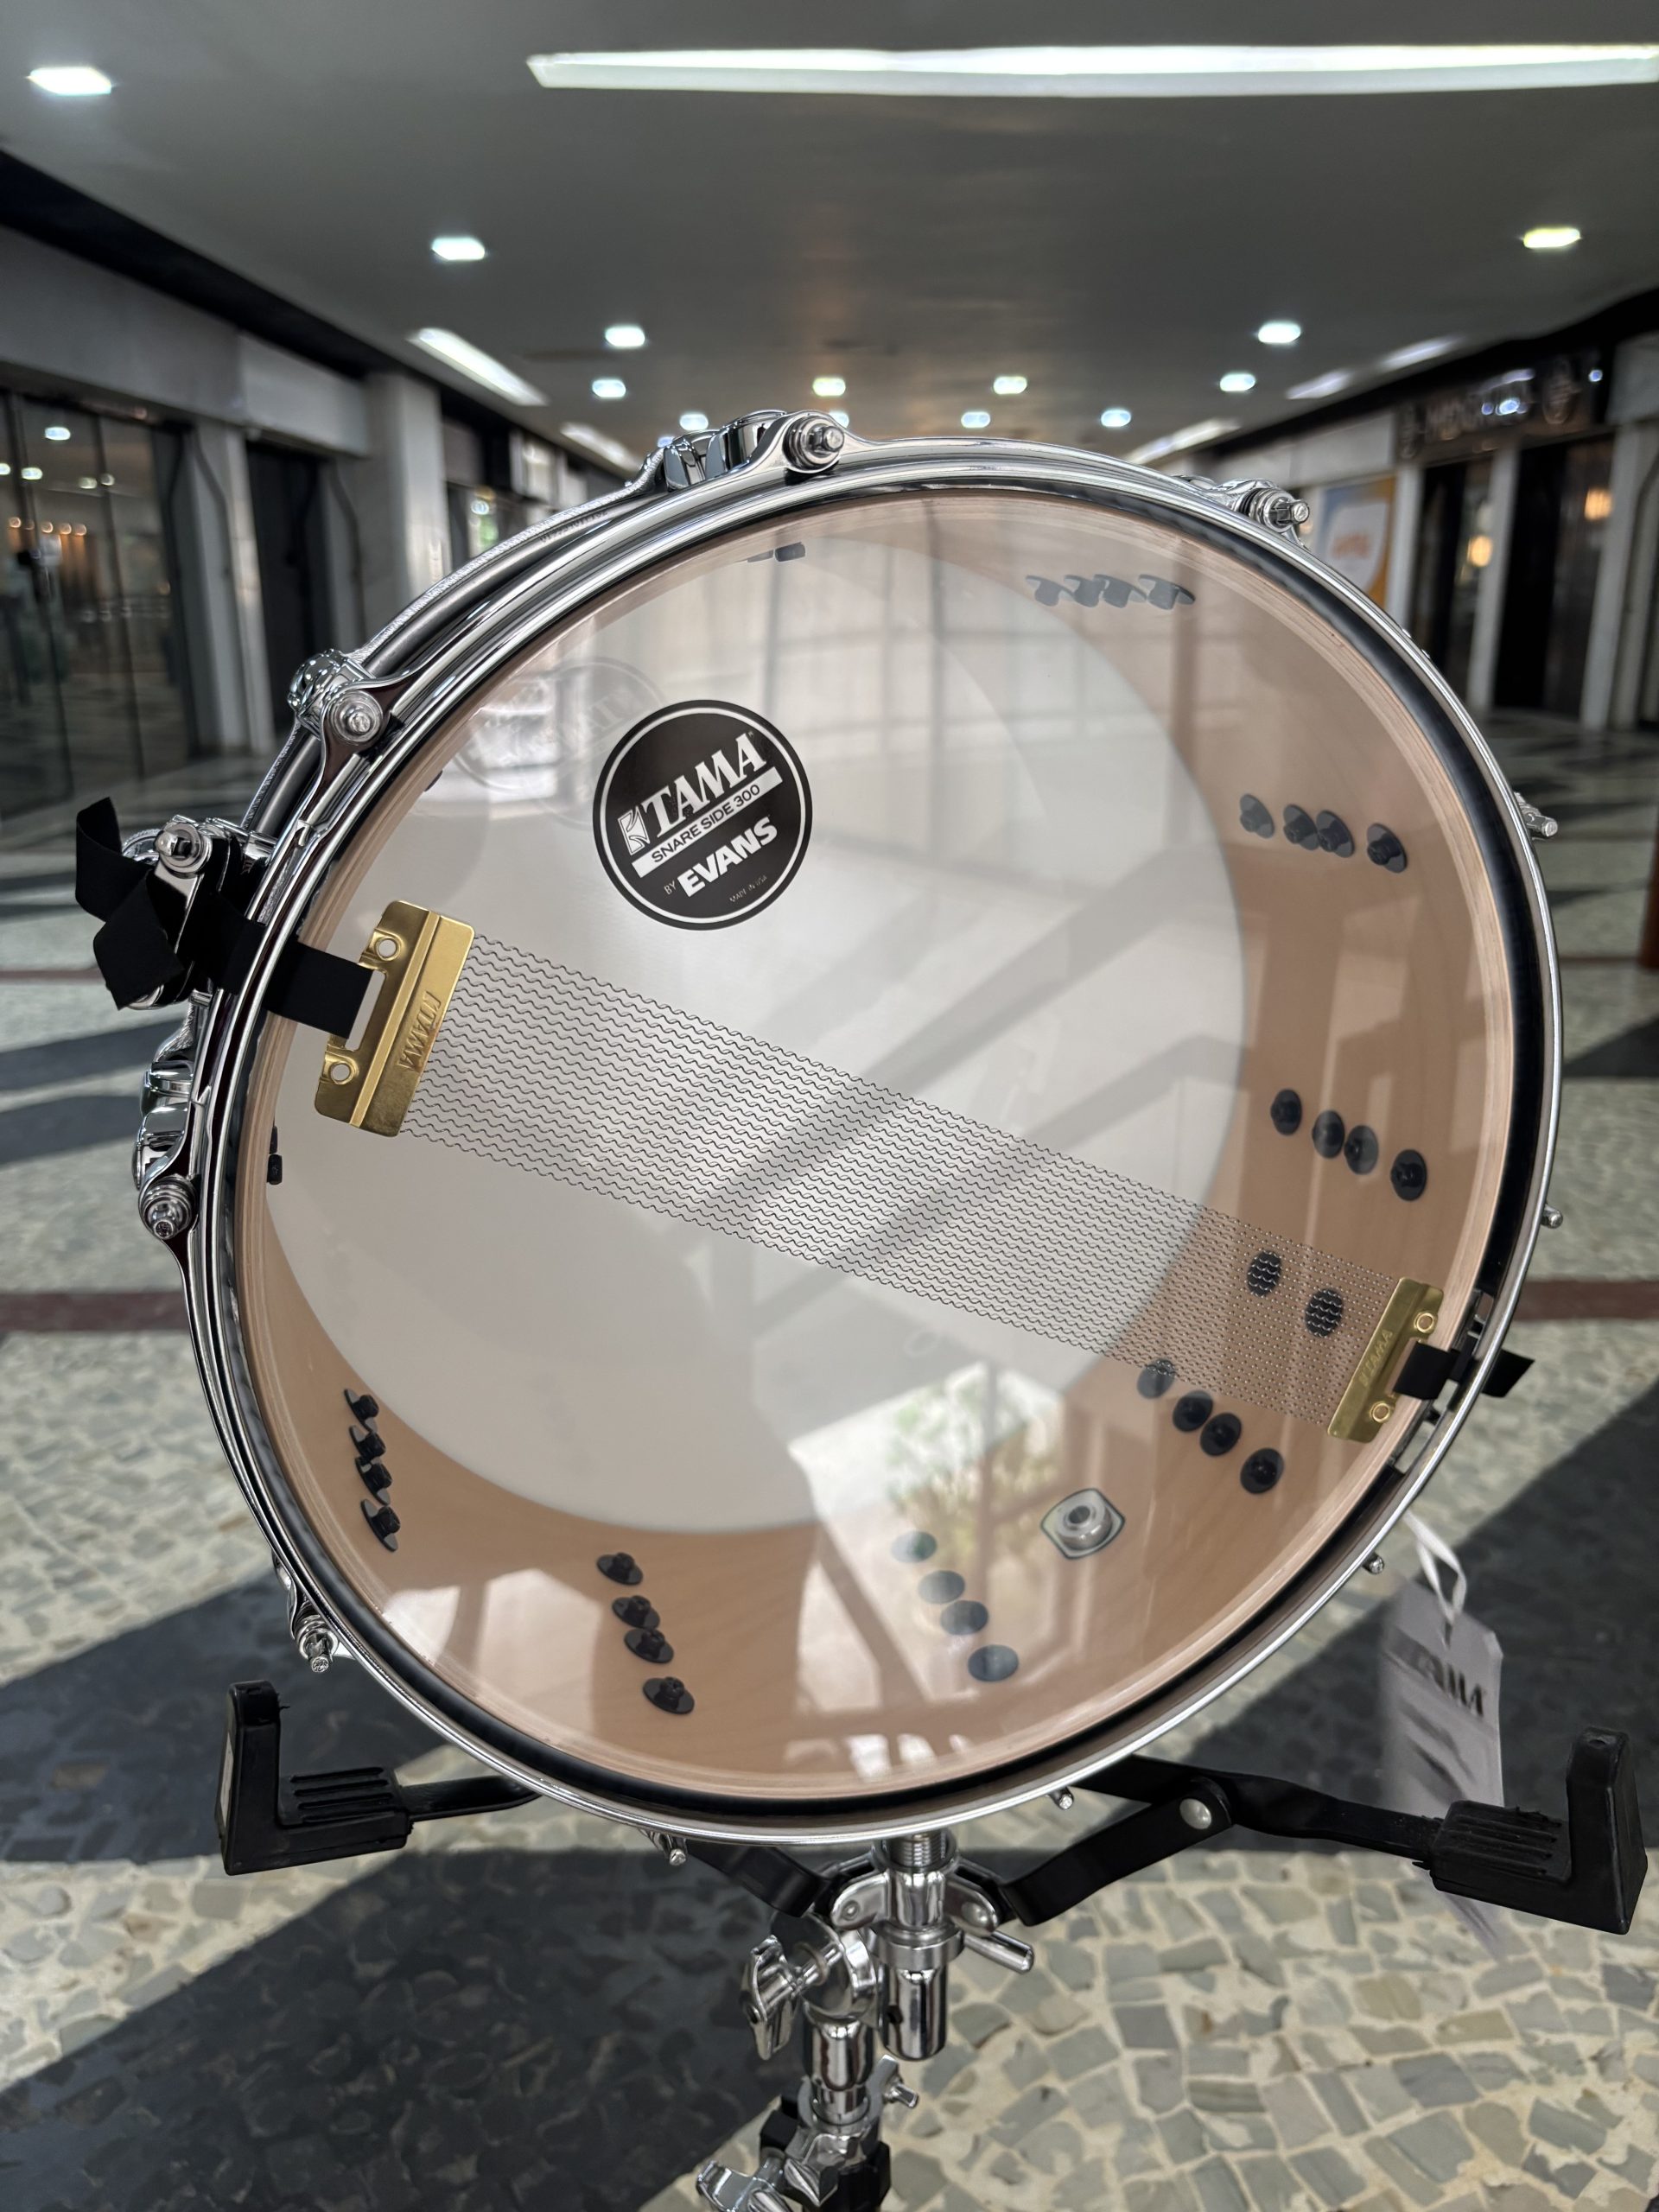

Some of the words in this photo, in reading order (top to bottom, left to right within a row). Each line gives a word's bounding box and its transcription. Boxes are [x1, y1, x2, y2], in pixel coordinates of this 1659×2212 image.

[641, 733, 766, 838] TAMA
[652, 824, 702, 862] SNARE
[700, 802, 734, 830] SIDE
[733, 784, 760, 807] 300
[664, 880, 677, 895] BY
[677, 817, 778, 898] EVANS
[397, 1008, 437, 1071] TAMA
